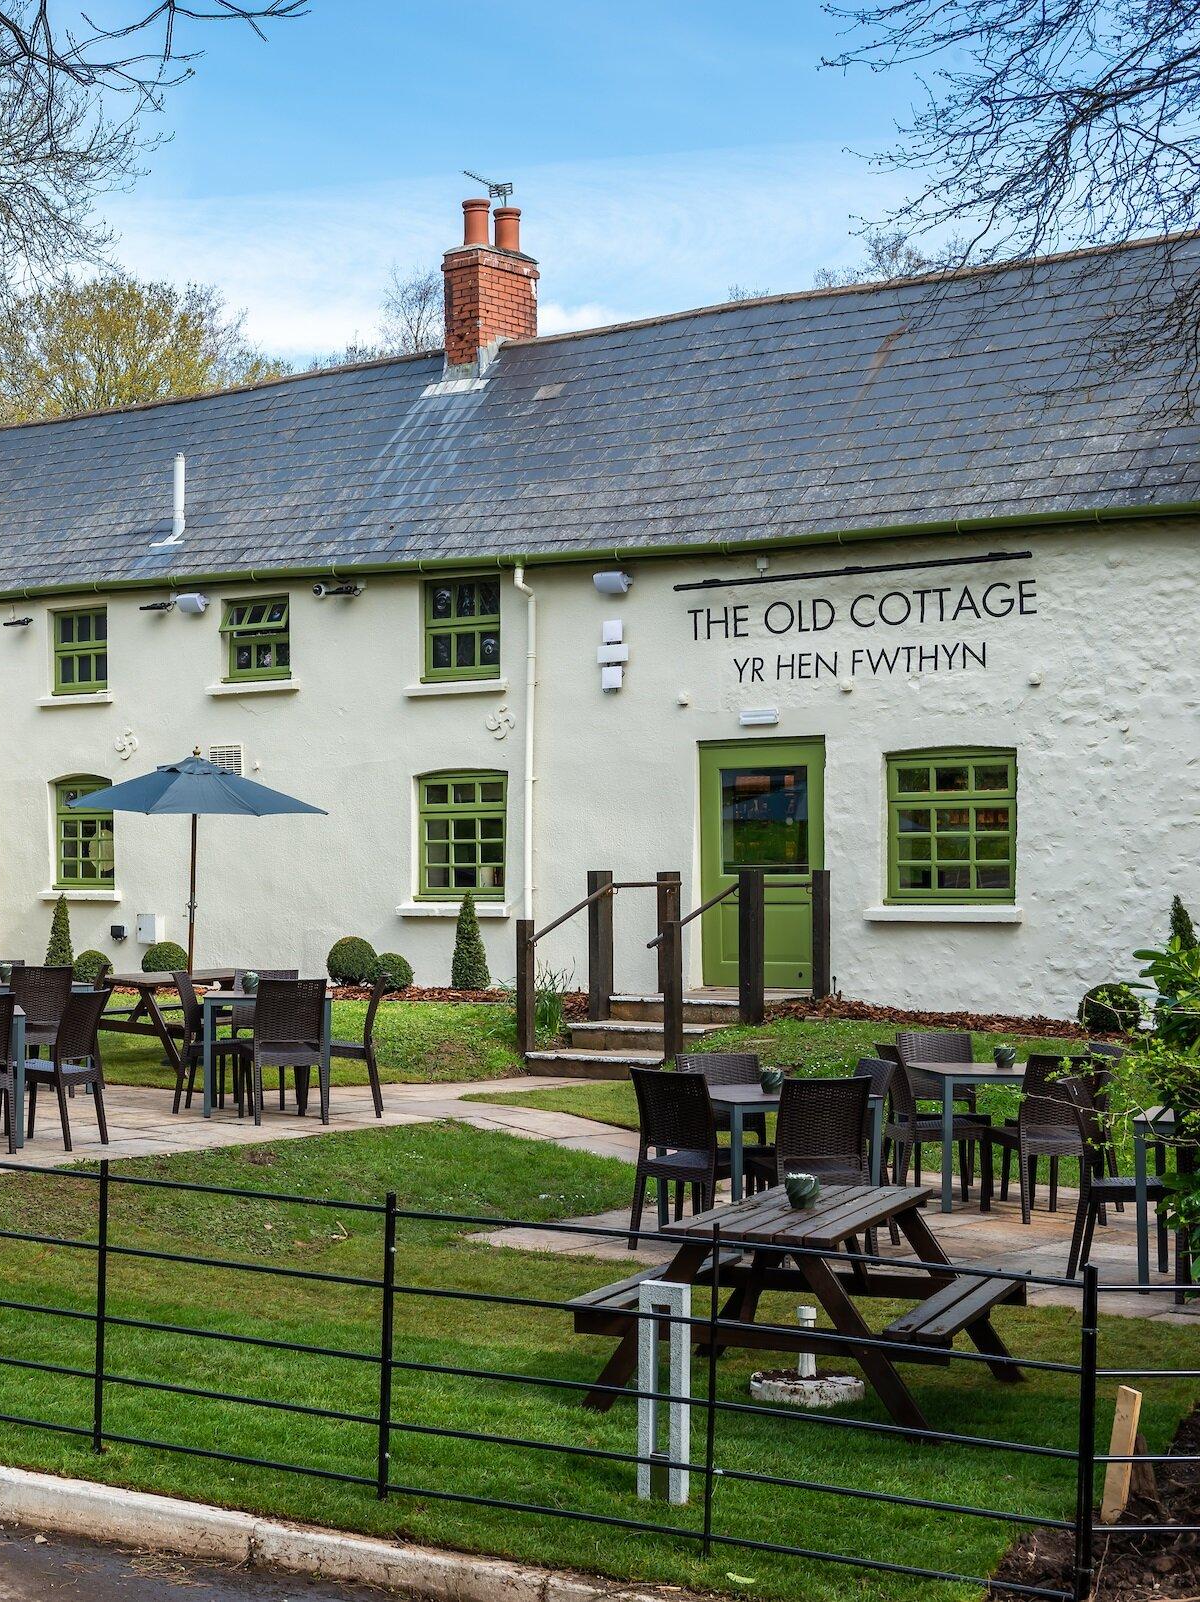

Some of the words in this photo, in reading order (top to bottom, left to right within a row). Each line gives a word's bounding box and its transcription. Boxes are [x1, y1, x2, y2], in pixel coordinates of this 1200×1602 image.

[688, 605, 749, 640] THE
[764, 599, 835, 634] OLD
[850, 580, 1037, 627] COTTAGE
[733, 657, 764, 683] YR
[777, 652, 837, 680] HEN
[852, 642, 986, 675] FWTHYN
